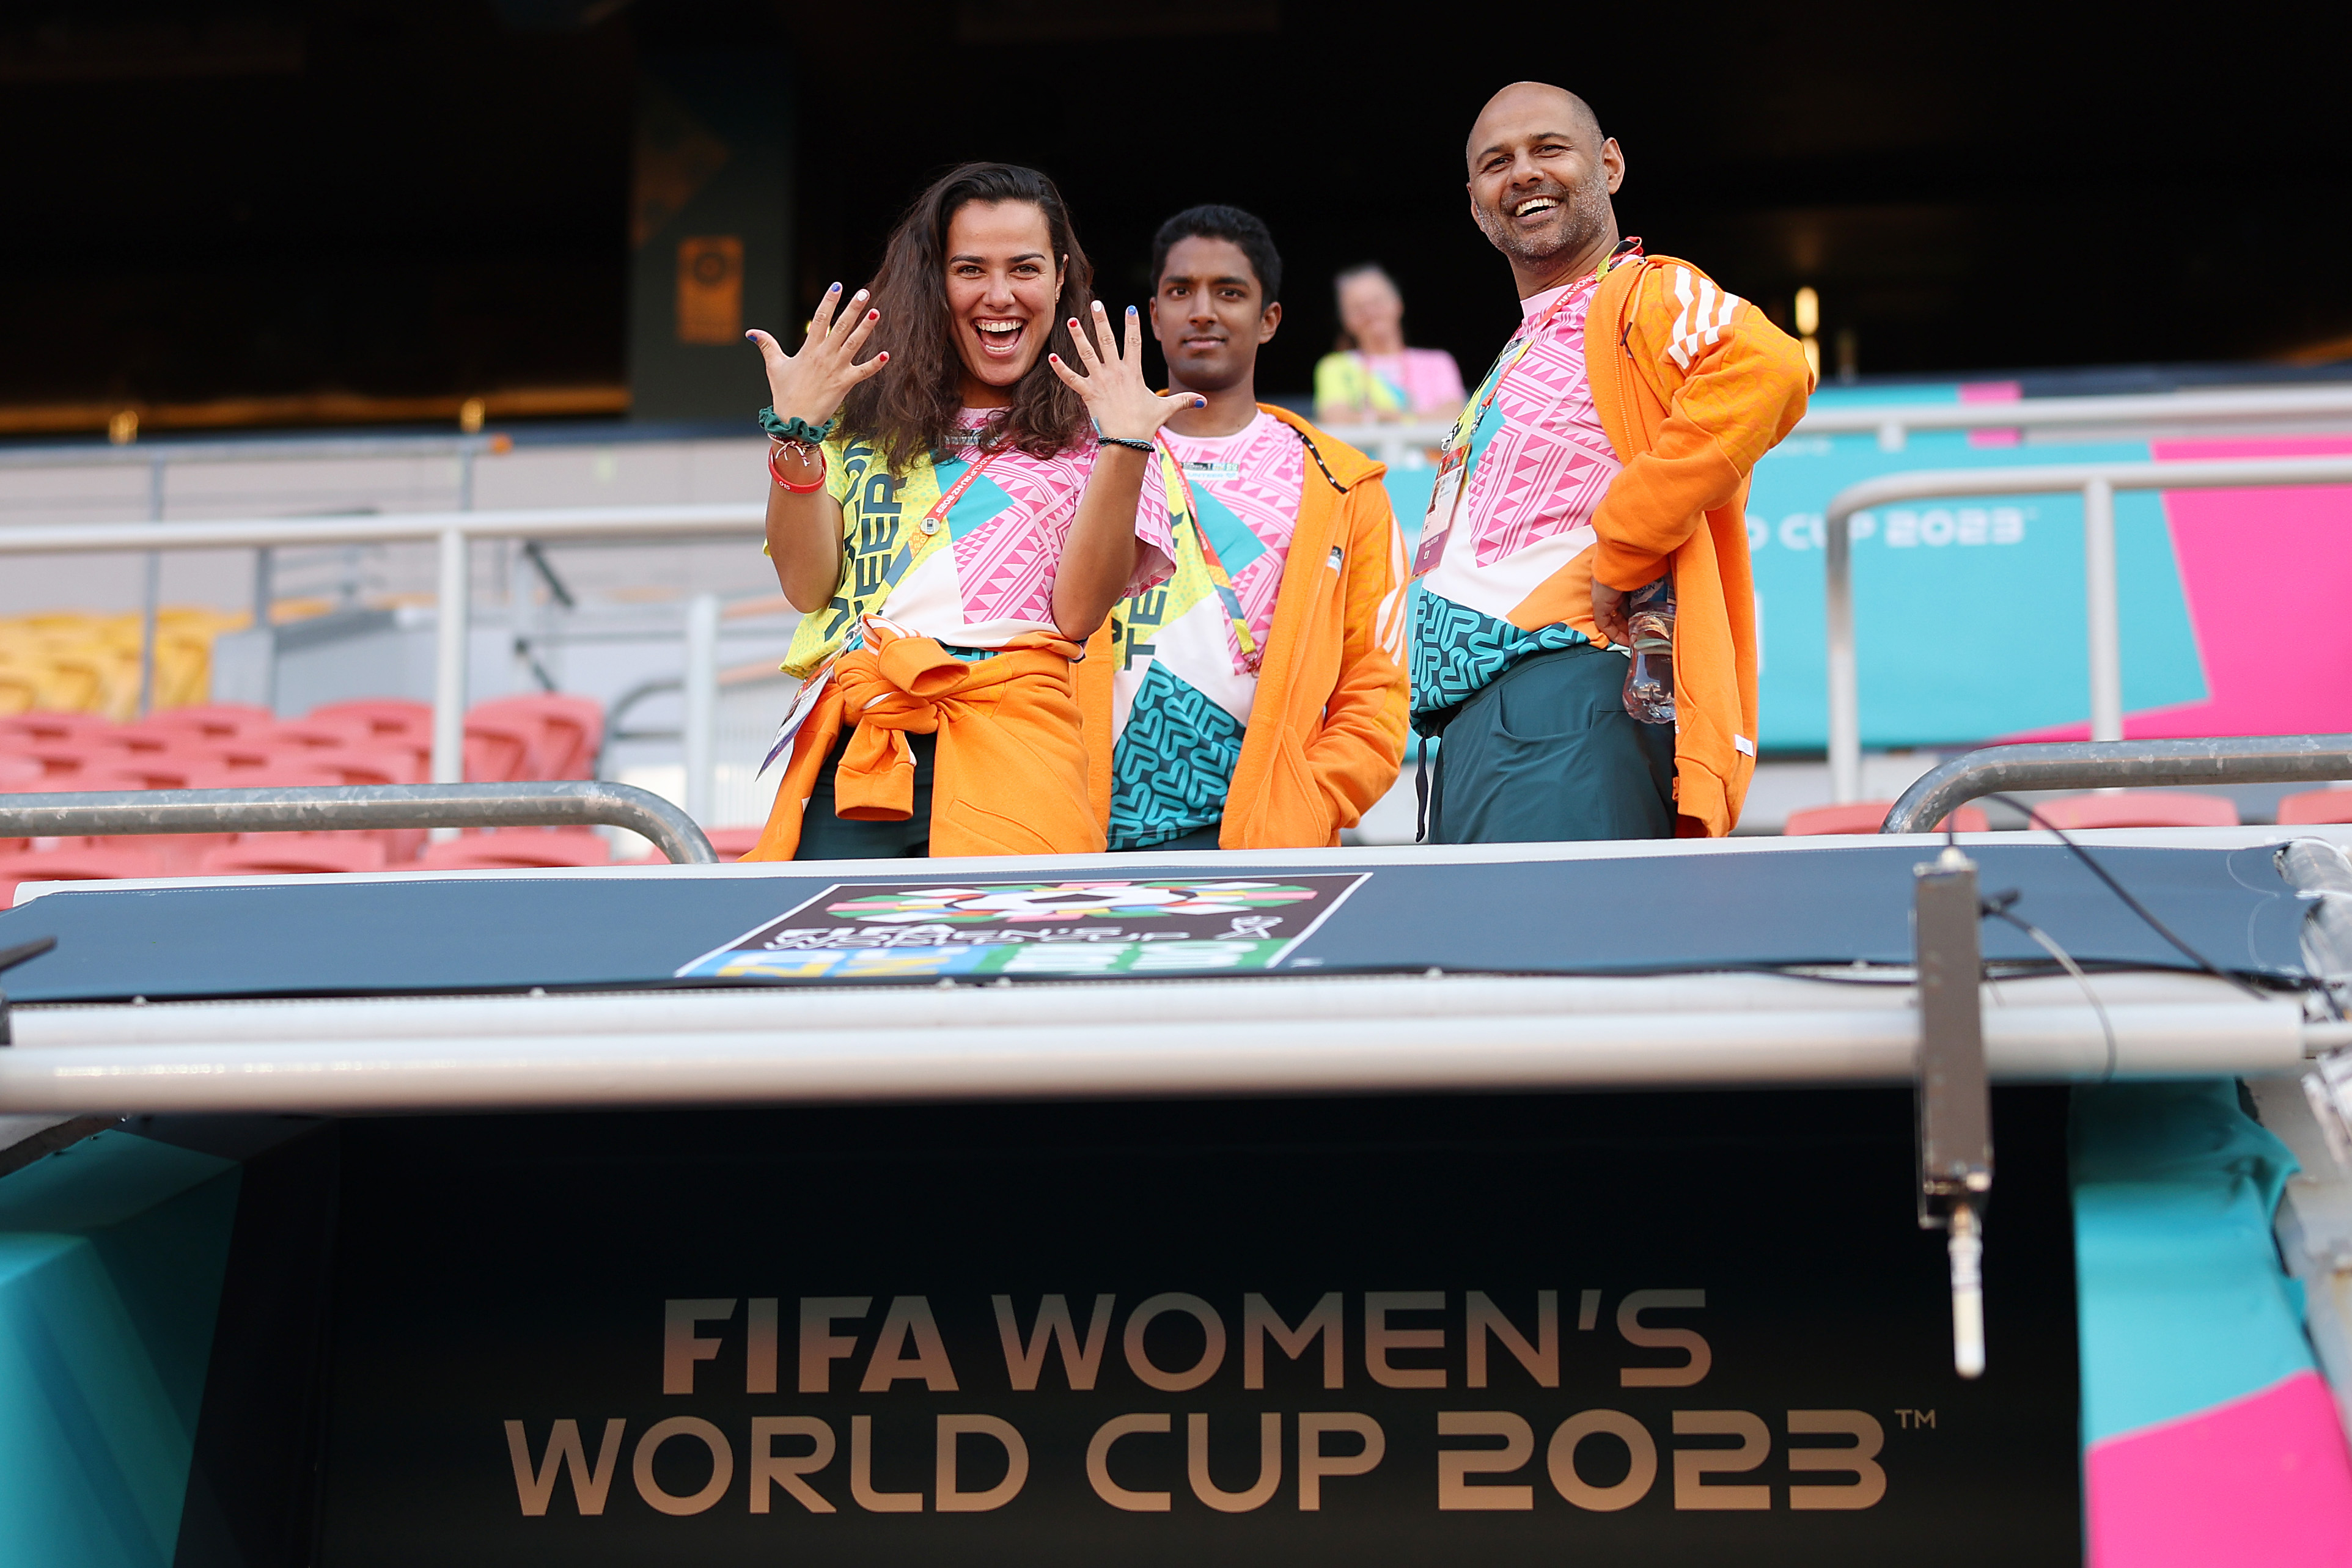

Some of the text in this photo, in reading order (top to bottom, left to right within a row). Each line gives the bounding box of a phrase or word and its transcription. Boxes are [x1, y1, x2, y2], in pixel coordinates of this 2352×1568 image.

[1556, 291, 1575, 306] FIFA
[969, 464, 982, 477] CUP
[1885, 507, 2025, 548] 2023
[663, 1289, 1712, 1394] FIFA WOMEN'S
[504, 1414, 1029, 1516] WORLD
[1086, 1412, 1386, 1513] CUP
[1437, 1409, 1887, 1512] 2023
